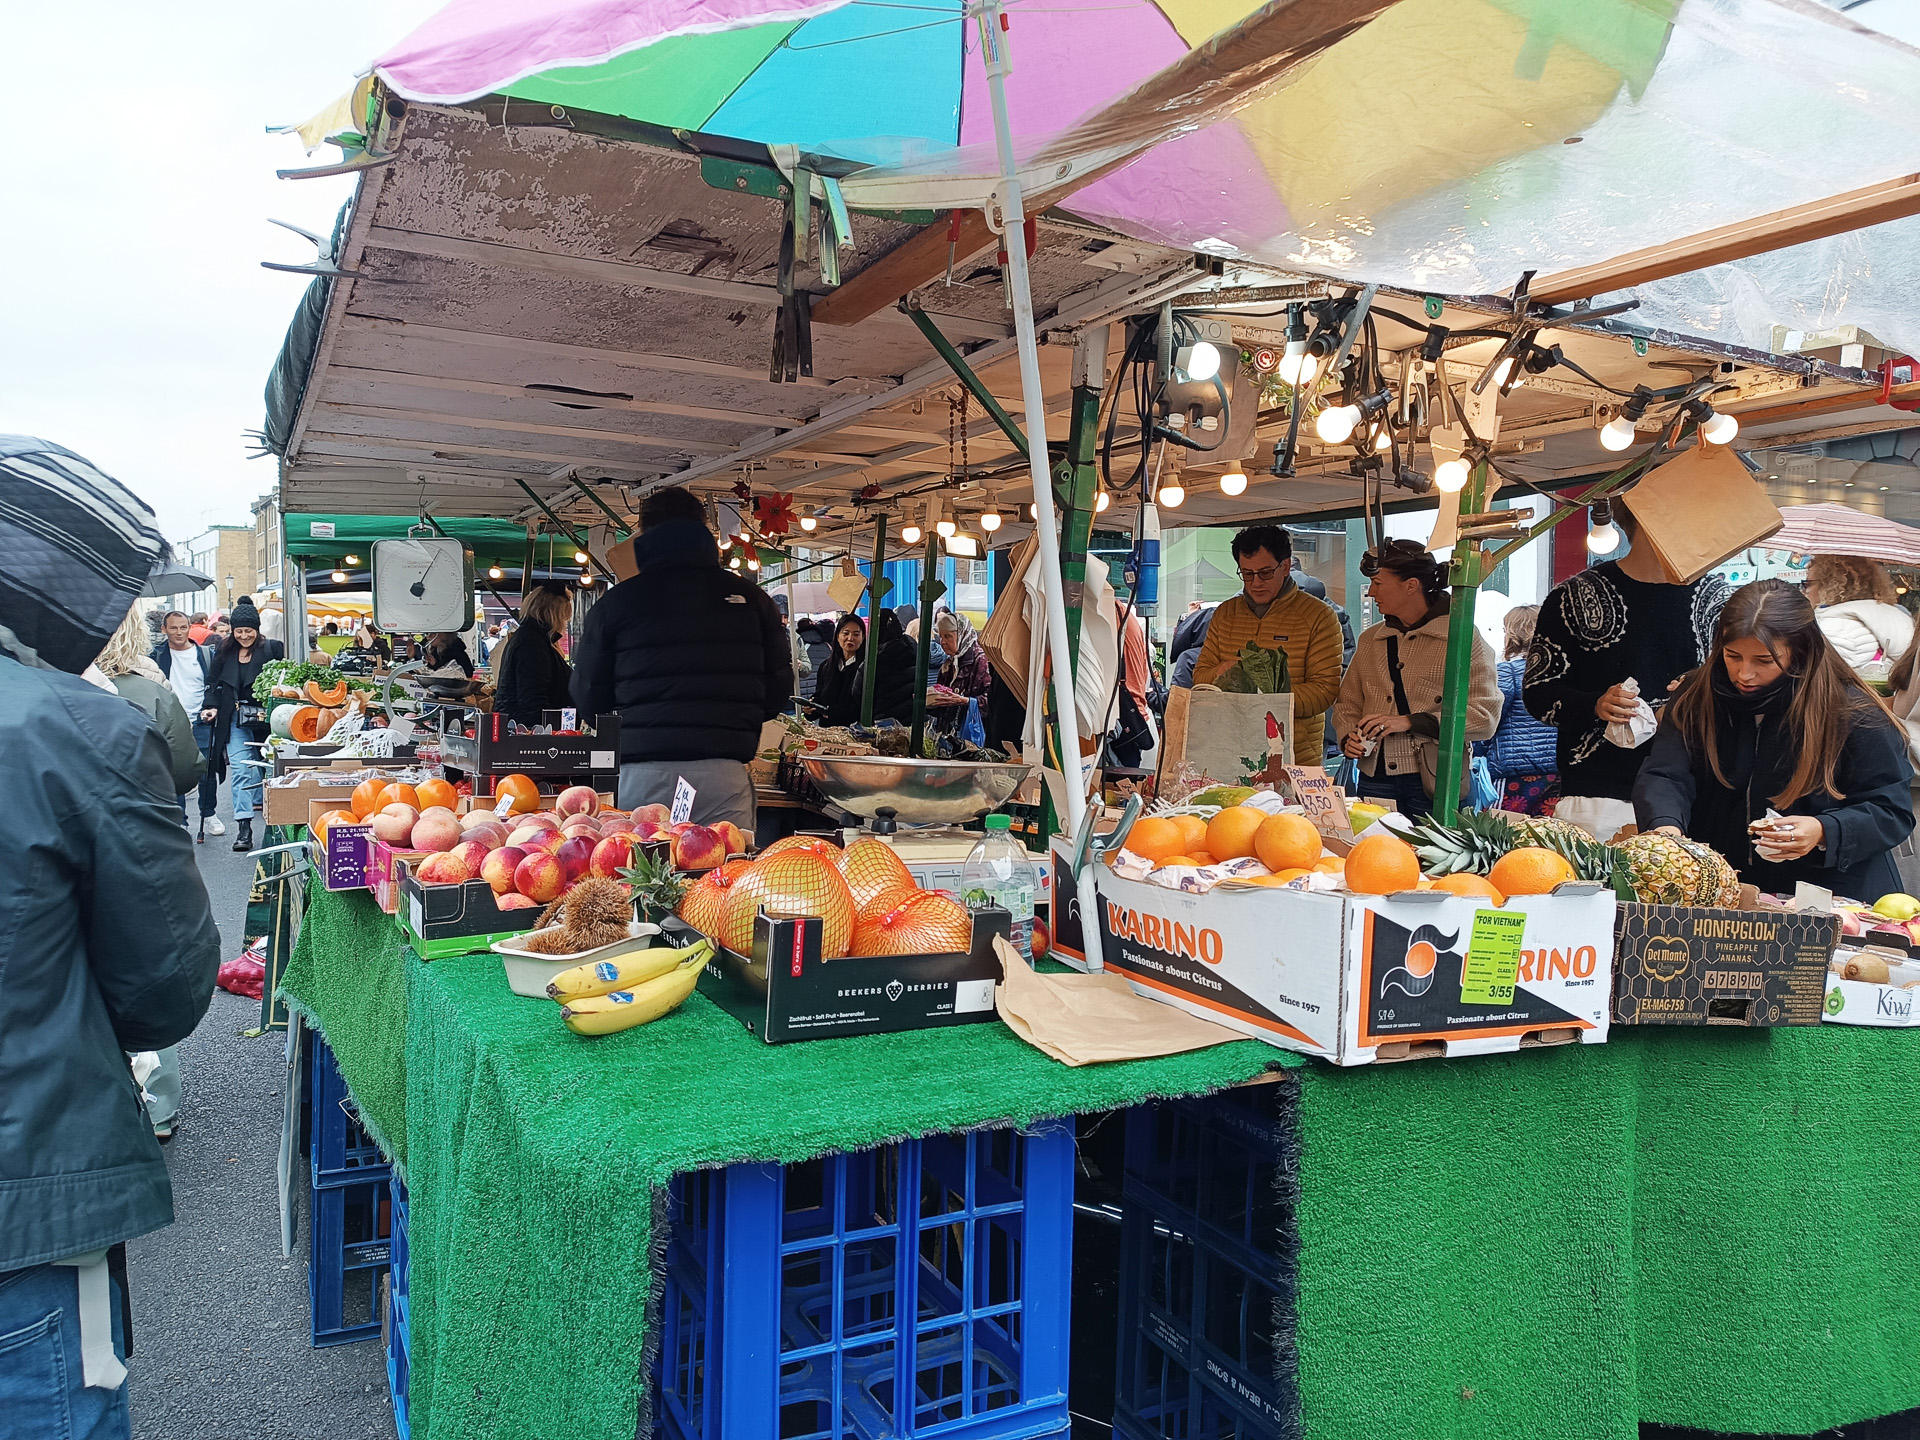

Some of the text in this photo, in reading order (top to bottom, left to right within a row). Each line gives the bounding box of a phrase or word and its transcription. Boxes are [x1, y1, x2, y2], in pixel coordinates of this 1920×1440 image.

[1476, 915, 1525, 927] "FOR VIETNAM"
[1107, 902, 1224, 965] KARINO
[1715, 943, 1759, 952] PINEAPPLE
[1648, 948, 1687, 962] Del Monte
[1720, 954, 1752, 963] ANANAS
[1122, 948, 1223, 992] Passionate about Citrus
[1708, 973, 1761, 987] 6 7 8 9 10
[838, 982, 949, 997] BEEKERS BERRIES
[1488, 985, 1513, 998] 3/55
[1279, 994, 1320, 1015] Since 1957
[1641, 998, 1685, 1011] EX-MAG-758
[1877, 988, 1912, 1017] Kiwi
[1446, 1011, 1529, 1025] Passionate about Citrus
[1206, 1359, 1229, 1383] SONS
[1230, 1376, 1237, 1389] &
[1238, 1382, 1262, 1407] BEAN
